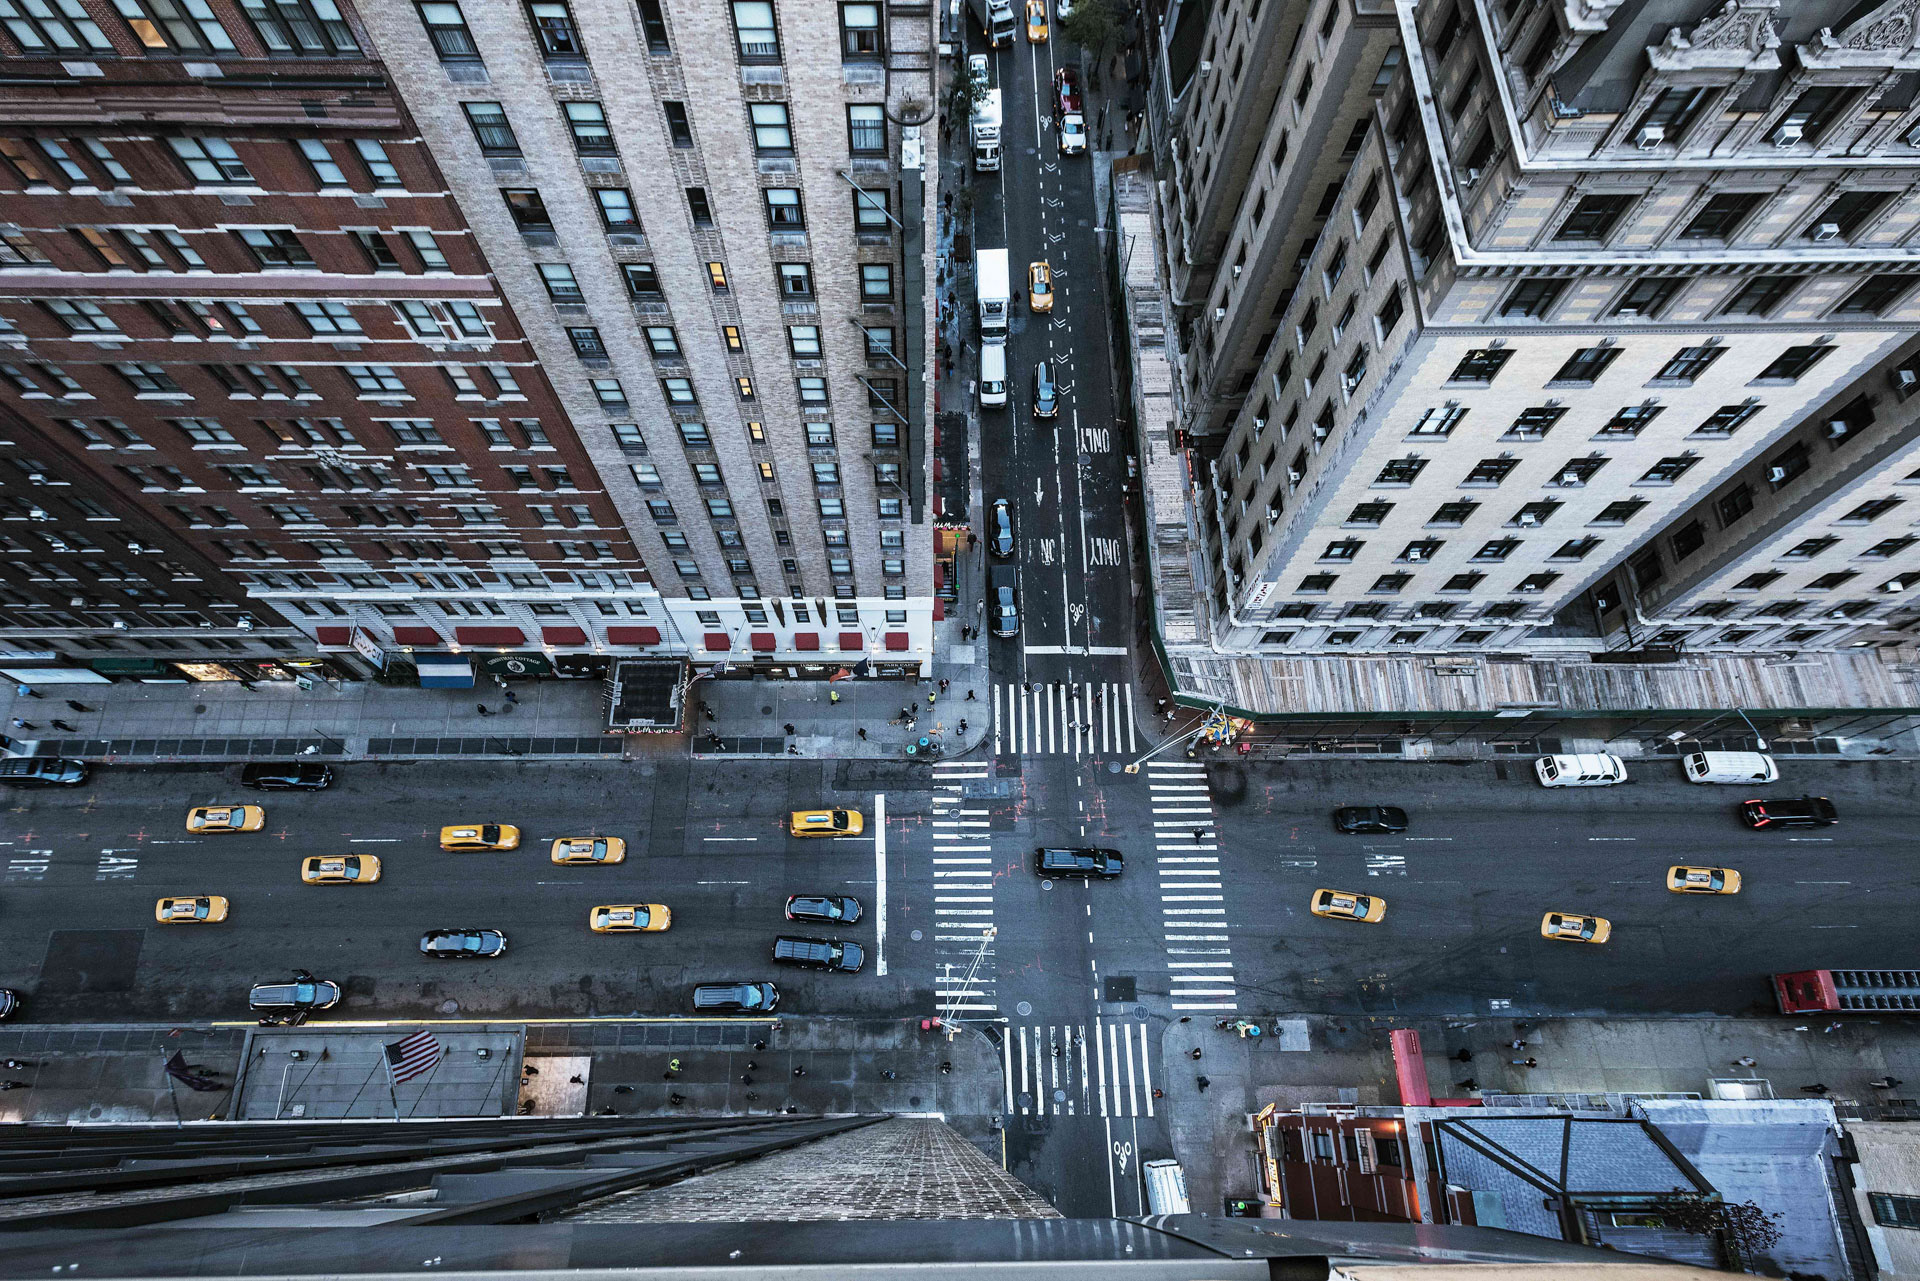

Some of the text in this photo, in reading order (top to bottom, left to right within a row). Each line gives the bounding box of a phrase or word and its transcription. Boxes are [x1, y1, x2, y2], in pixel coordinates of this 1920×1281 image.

[1080, 427, 1110, 453] ONLY
[1090, 537, 1121, 566] ONLY
[514, 656, 541, 665] COTTAGE
[95, 848, 140, 880] LANE
[1362, 844, 1407, 876] LANE
